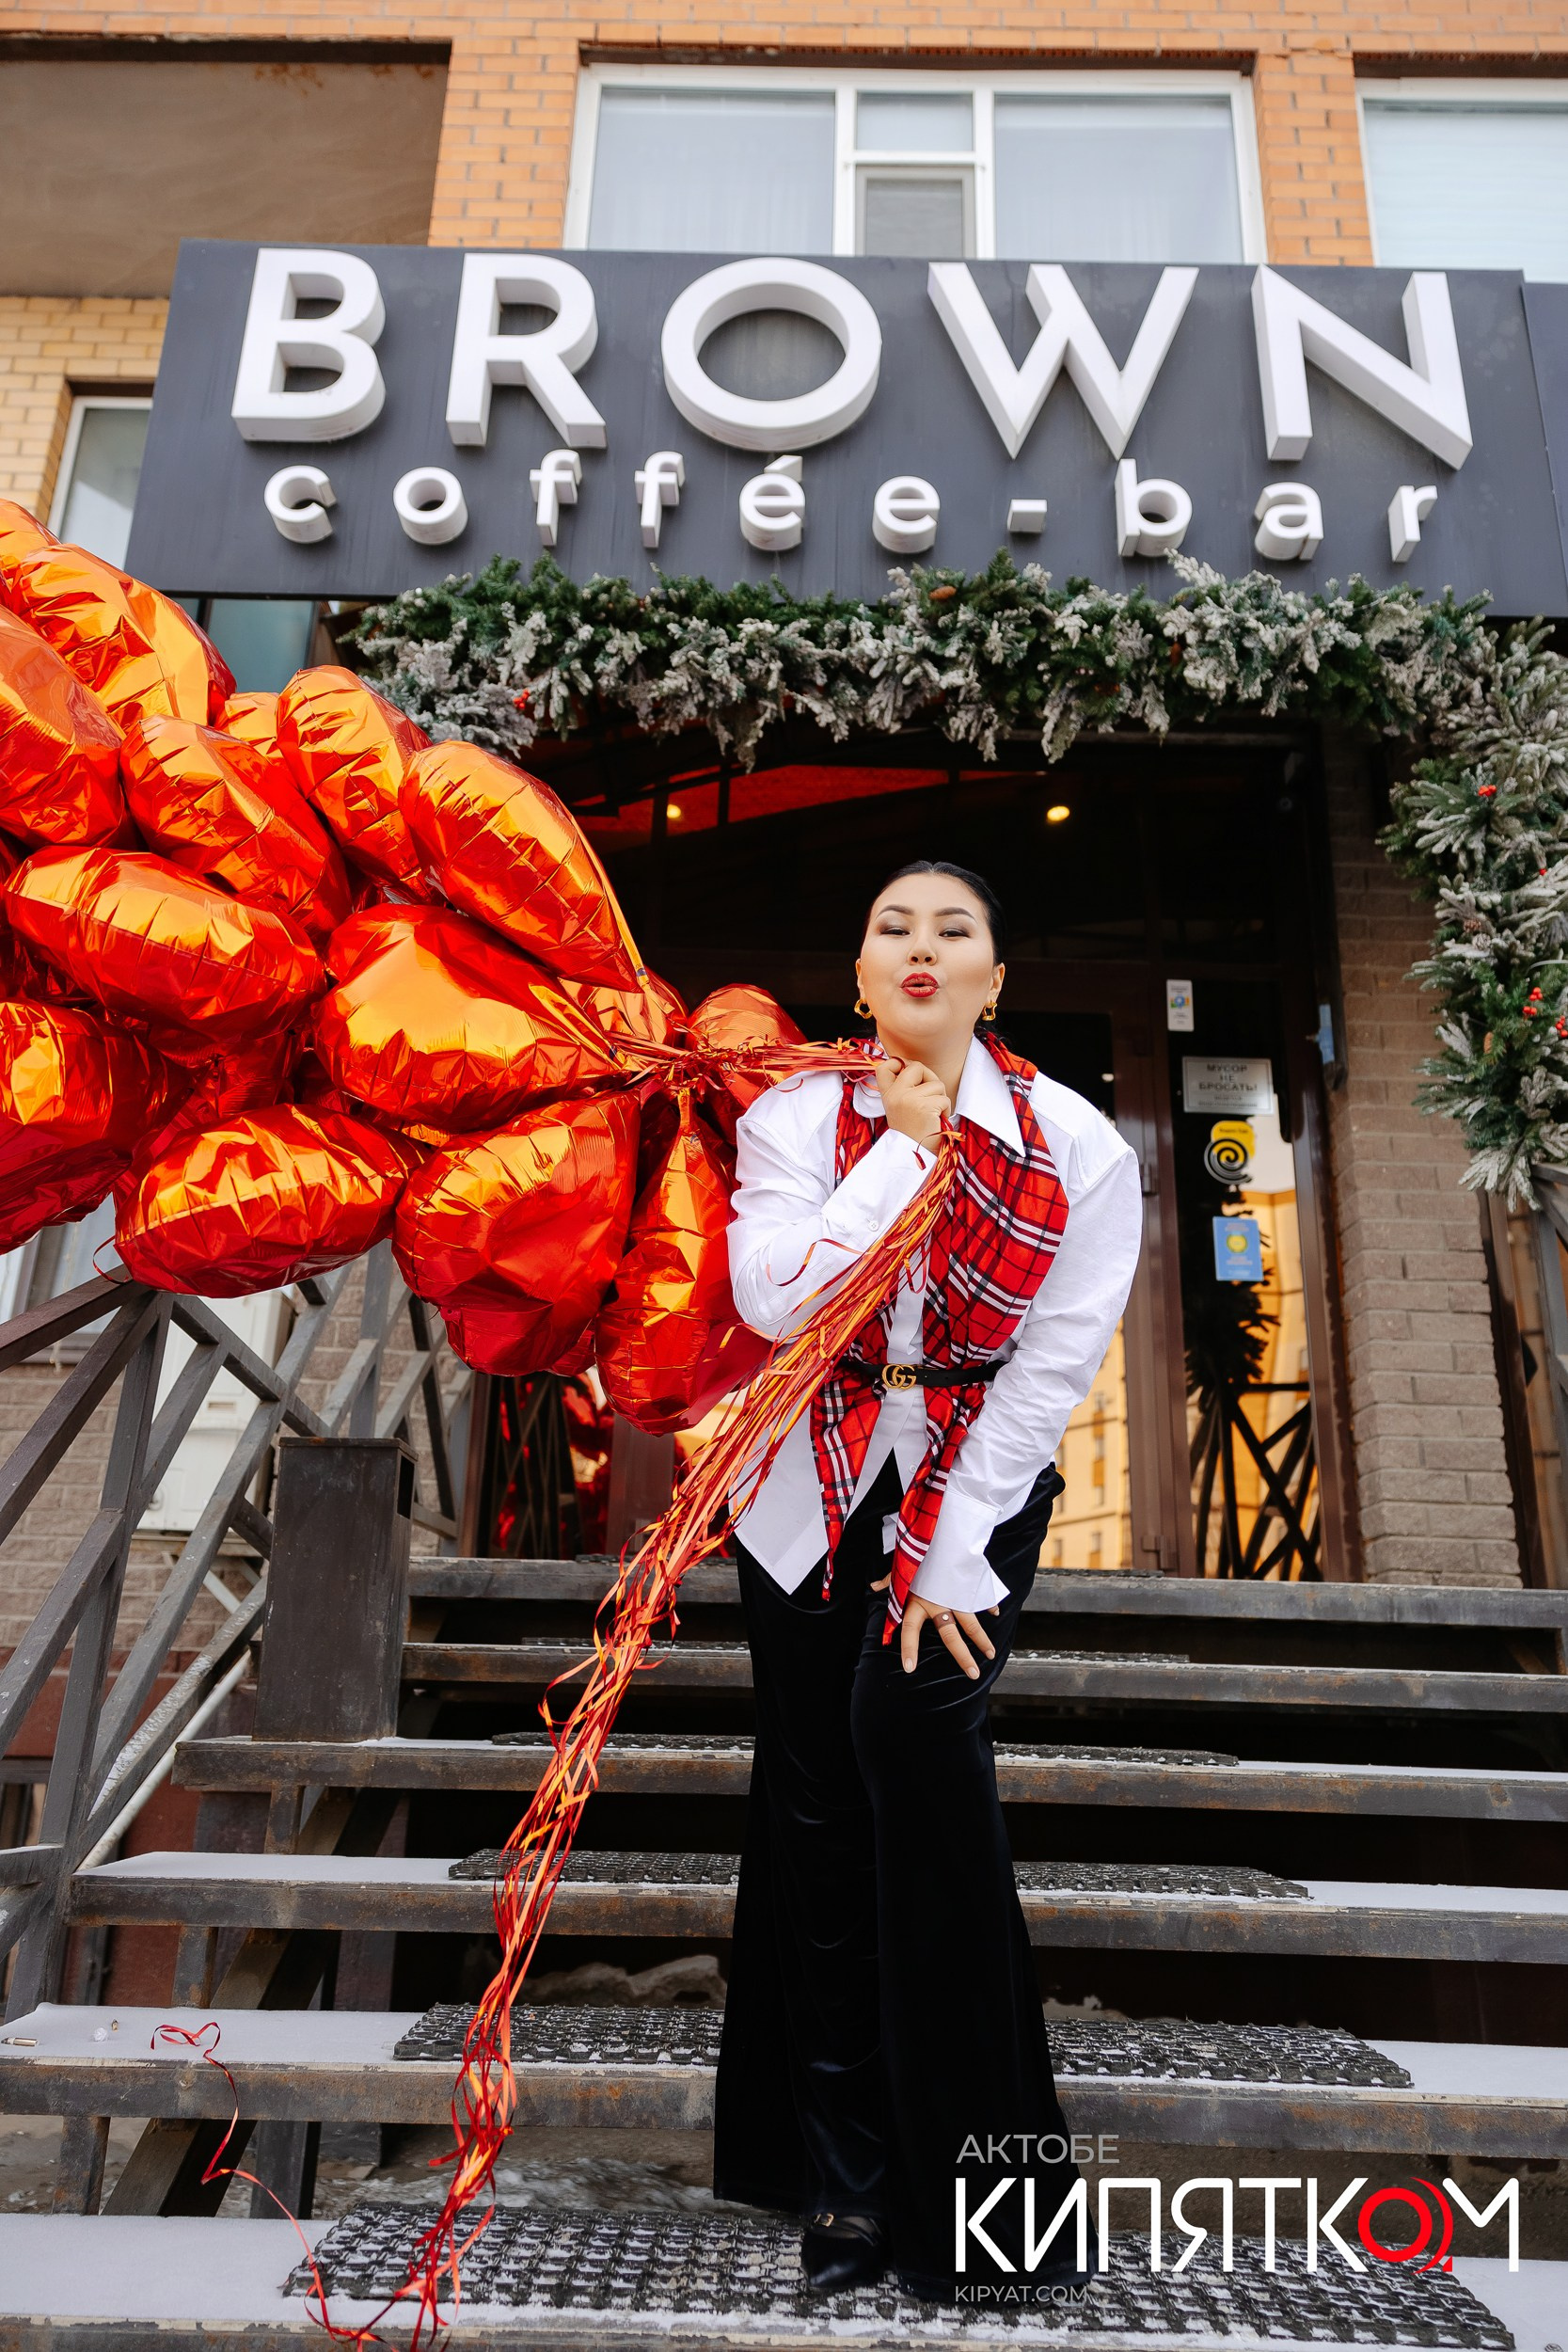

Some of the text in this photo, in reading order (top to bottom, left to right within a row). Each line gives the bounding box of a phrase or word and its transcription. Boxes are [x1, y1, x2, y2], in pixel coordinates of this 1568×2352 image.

[231, 247, 1473, 470] BROWN
[1220, 1074, 1235, 1083] НЕ
[1198, 1082, 1258, 1091] БРОСАТЬ!
